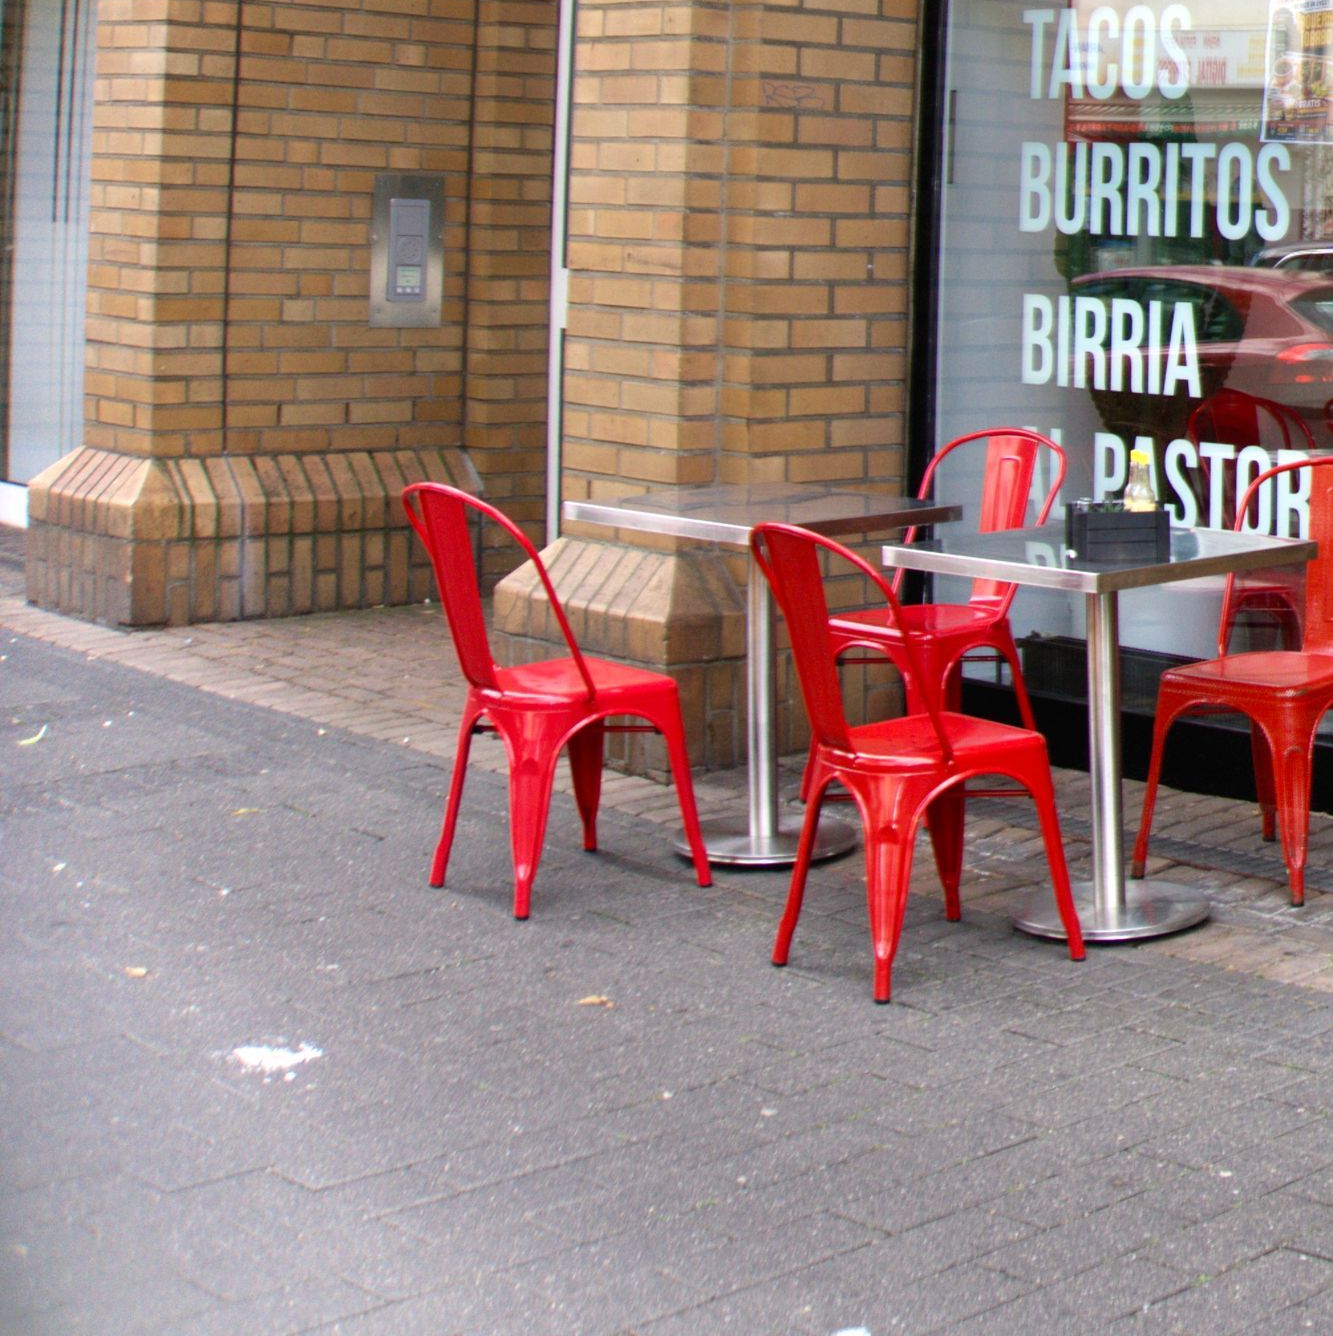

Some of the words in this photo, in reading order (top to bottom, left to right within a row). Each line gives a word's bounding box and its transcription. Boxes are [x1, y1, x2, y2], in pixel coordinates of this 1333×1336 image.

[1023, 4, 1193, 101] TACOS
[1019, 141, 1291, 242] BURRITOS
[1022, 293, 1202, 400] BIRRIA
